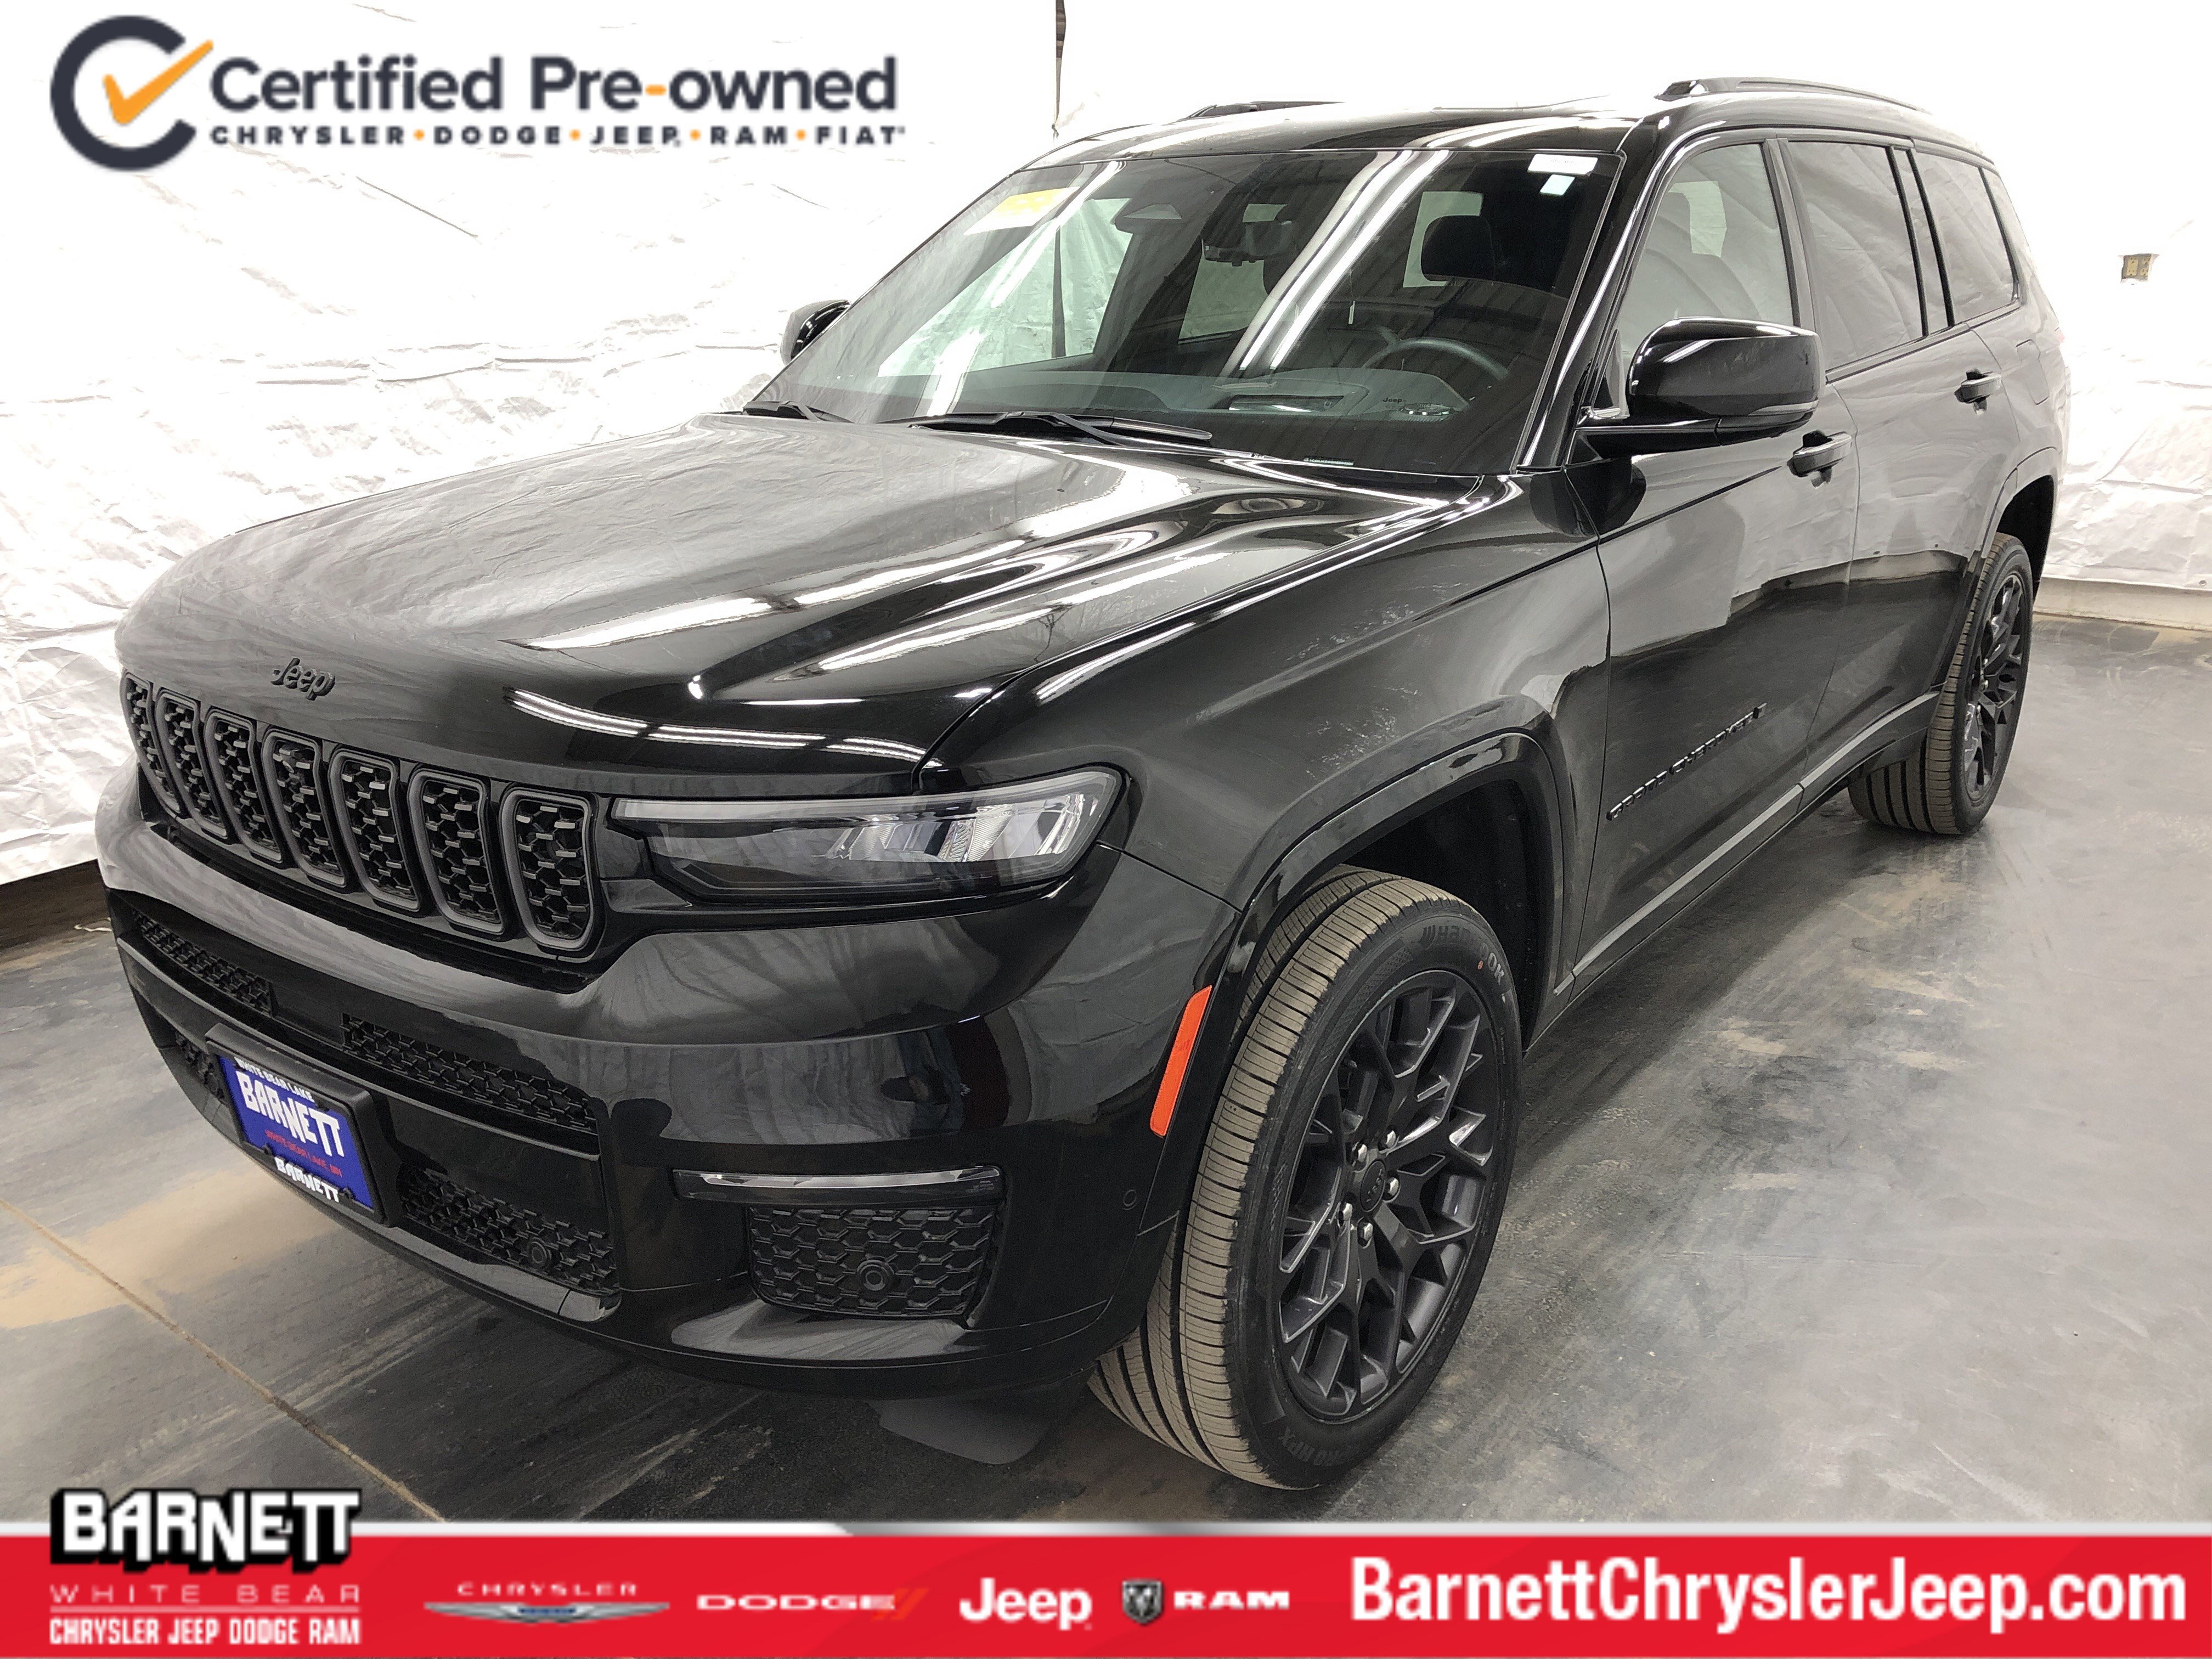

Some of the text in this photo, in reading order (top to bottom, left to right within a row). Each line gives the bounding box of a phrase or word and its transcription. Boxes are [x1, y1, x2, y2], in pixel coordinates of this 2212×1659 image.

[270, 657, 336, 701] Jeep
[235, 1070, 345, 1158] BARNETT
[287, 1082, 315, 1103] LAKE
[274, 1156, 339, 1203] BARNETT
